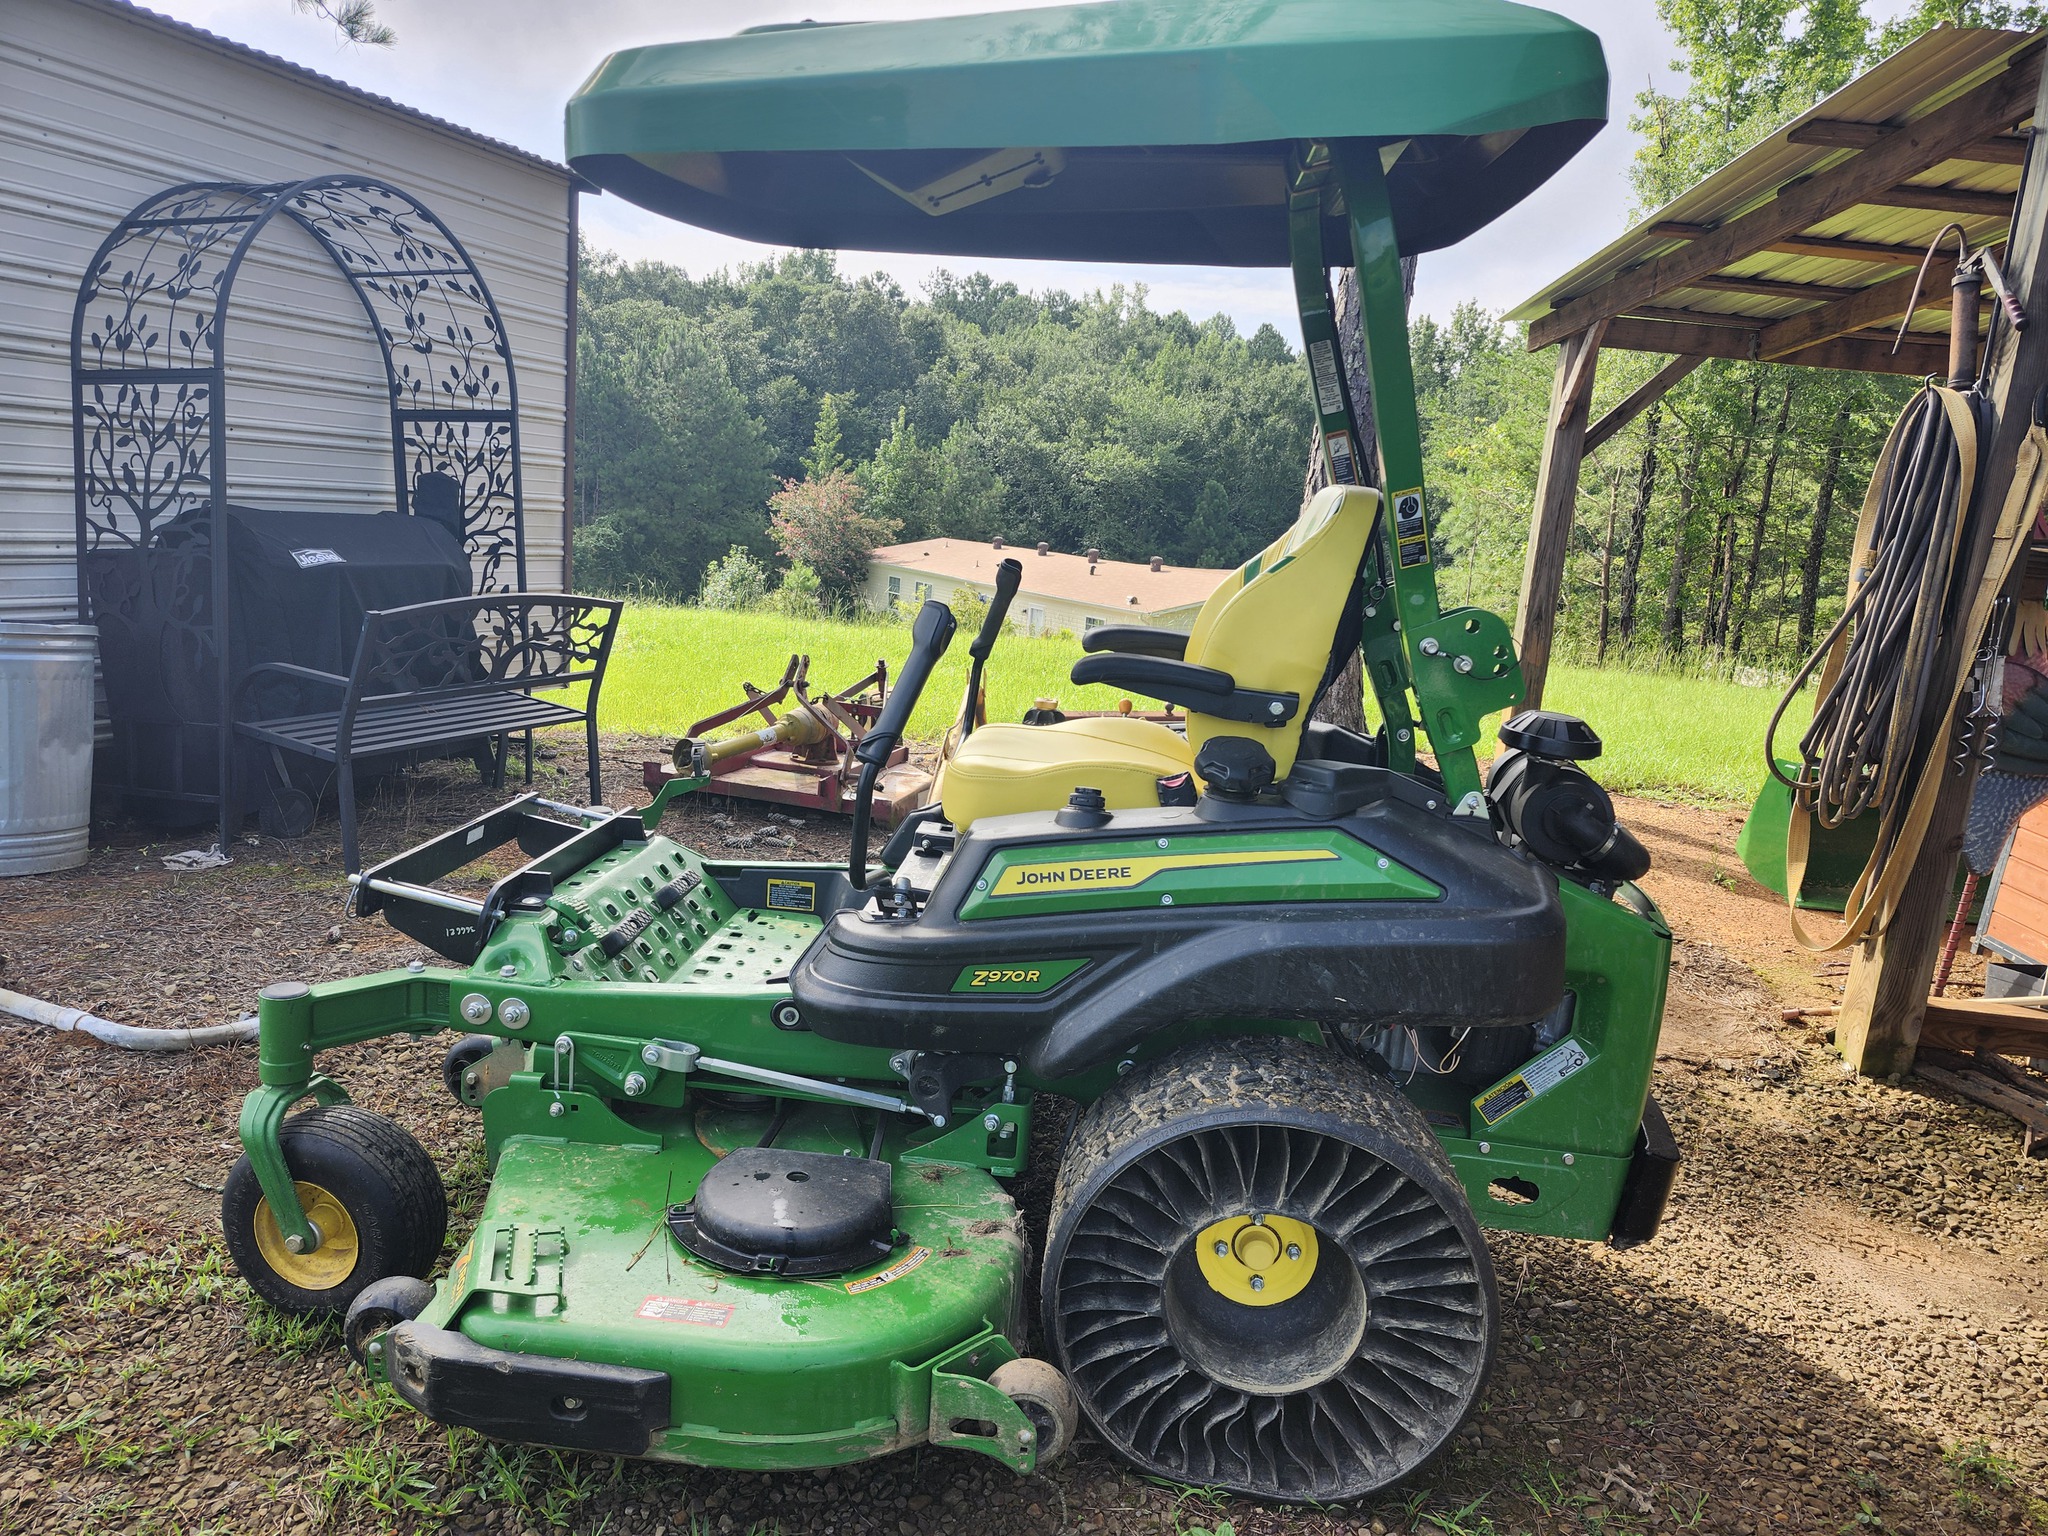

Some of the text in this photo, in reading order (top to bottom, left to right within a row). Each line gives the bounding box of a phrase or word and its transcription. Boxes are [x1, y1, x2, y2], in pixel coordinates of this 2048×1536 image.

[1016, 866, 1132, 885] JOHN DEERE
[970, 968, 1041, 987] Z970R
